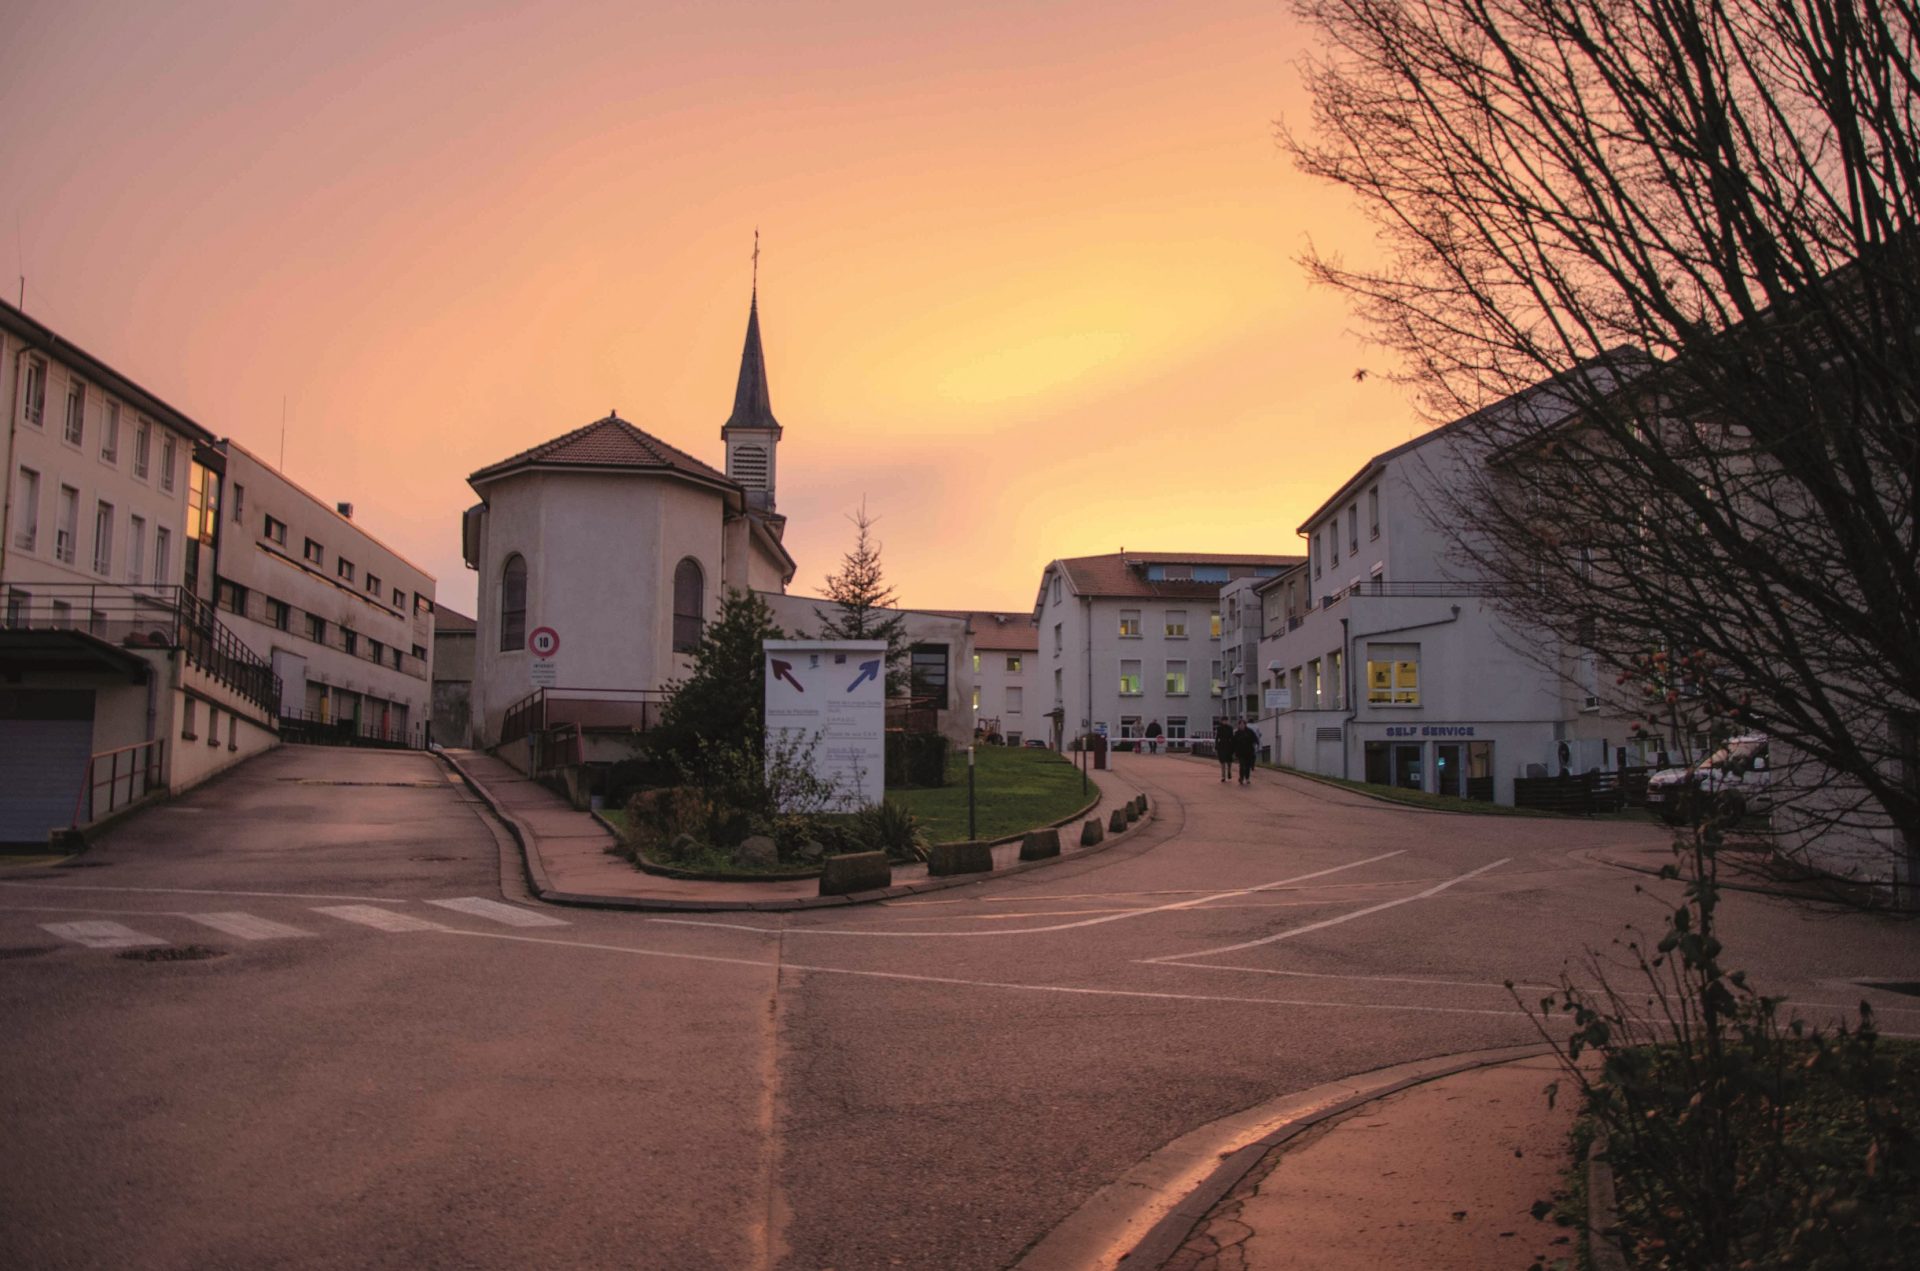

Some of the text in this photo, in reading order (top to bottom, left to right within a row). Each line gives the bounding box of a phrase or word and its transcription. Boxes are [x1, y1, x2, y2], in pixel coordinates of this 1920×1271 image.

[539, 637, 549, 648] 10
[1386, 726, 1474, 737] SELF SERVICE
